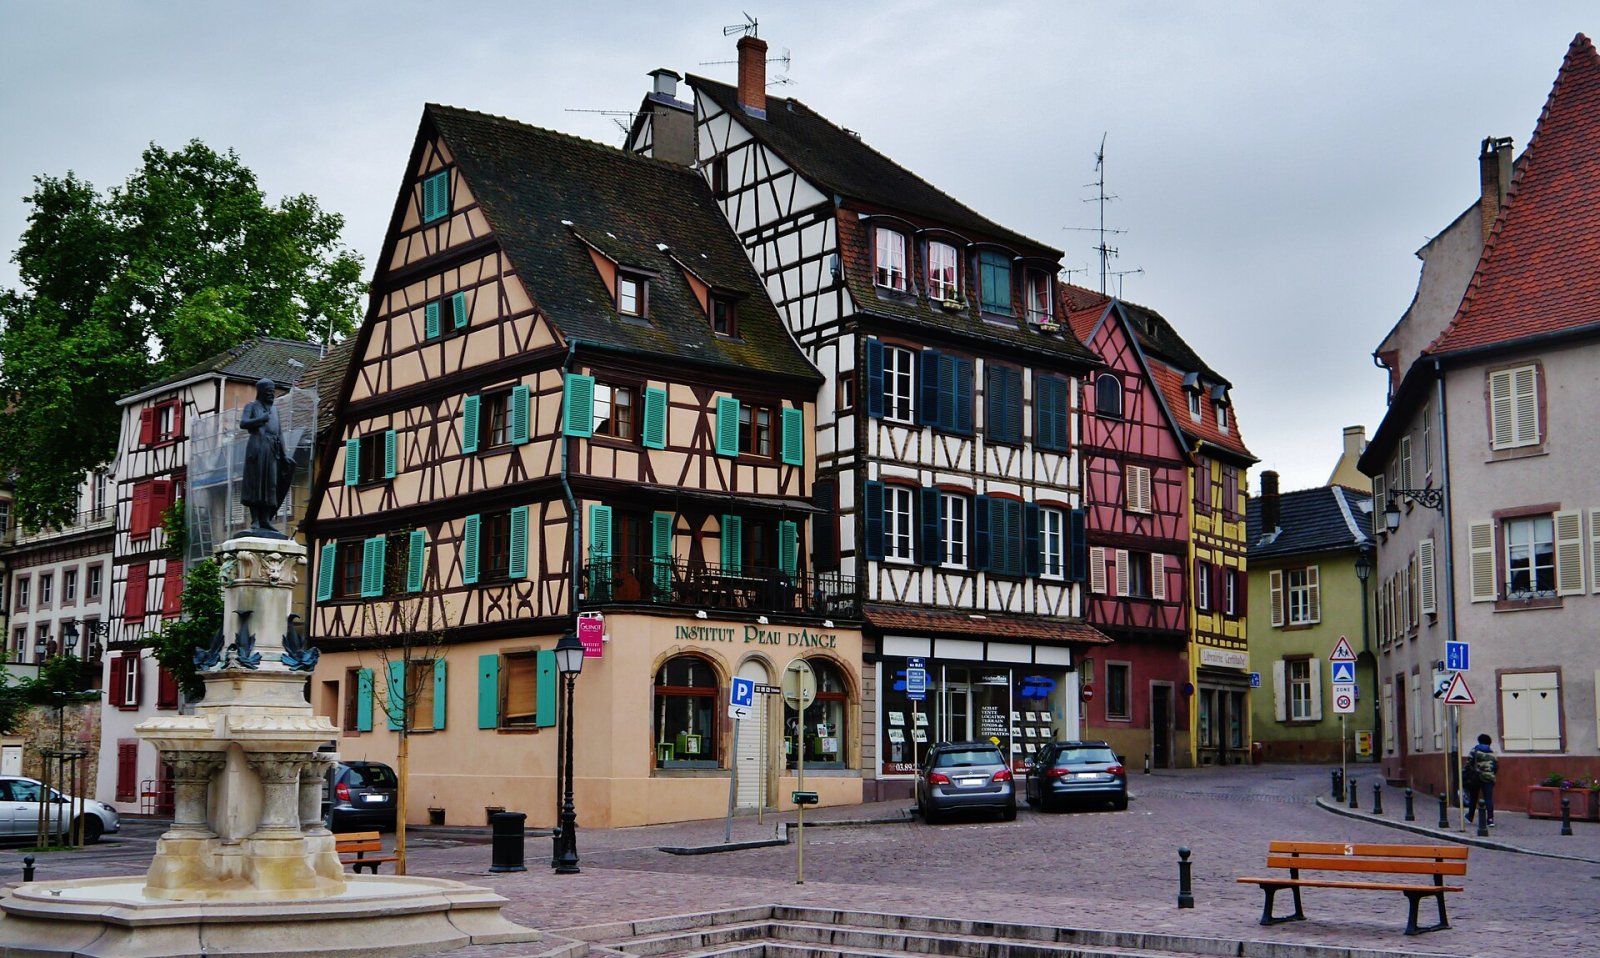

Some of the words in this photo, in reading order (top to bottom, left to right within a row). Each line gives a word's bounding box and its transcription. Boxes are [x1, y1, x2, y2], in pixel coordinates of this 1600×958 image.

[675, 625, 735, 642] INSTITUT
[743, 625, 781, 645] PEAU
[787, 628, 837, 648] D'ANGE
[737, 683, 748, 701] P
